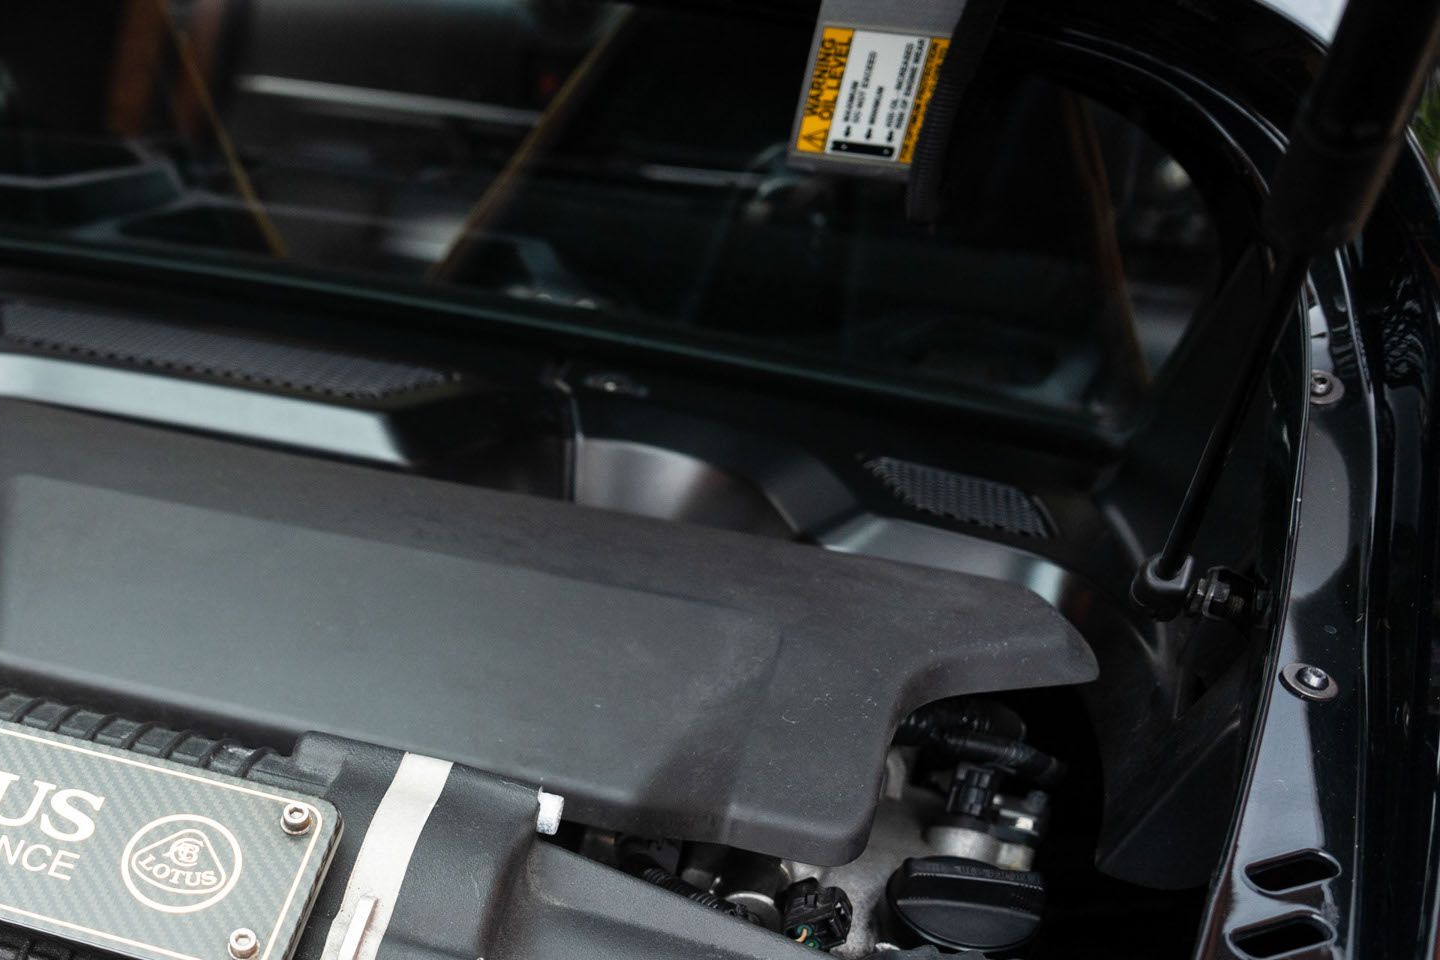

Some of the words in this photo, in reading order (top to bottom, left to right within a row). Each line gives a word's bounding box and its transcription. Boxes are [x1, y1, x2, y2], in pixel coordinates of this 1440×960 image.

[805, 38, 835, 116] WARNING
[825, 37, 851, 90] LEVEL
[138, 853, 218, 886] LOTUS
